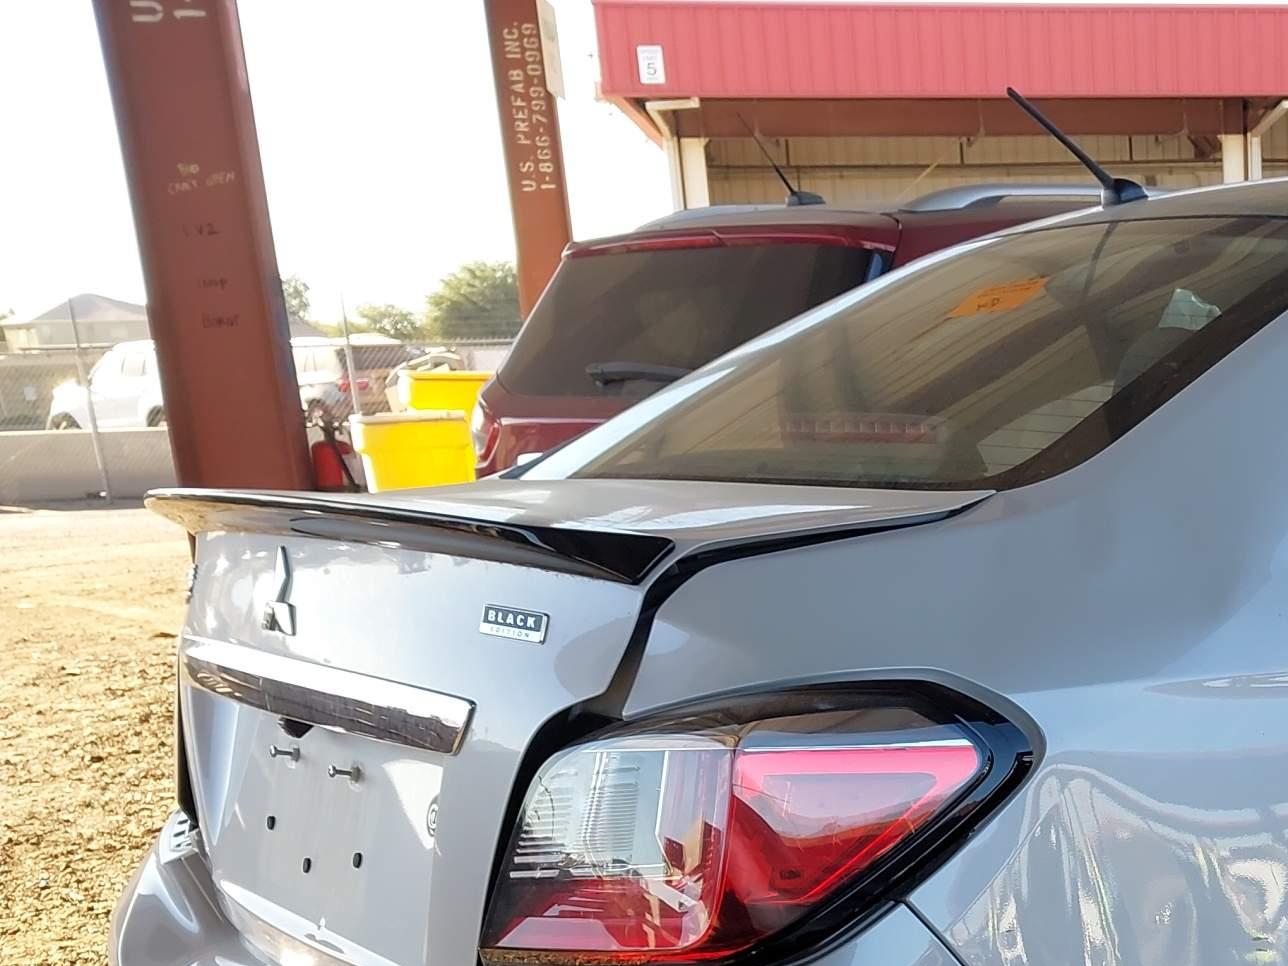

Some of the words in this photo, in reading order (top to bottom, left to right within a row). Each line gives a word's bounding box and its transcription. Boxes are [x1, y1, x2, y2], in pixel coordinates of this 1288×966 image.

[503, 21, 522, 59] INC.
[646, 62, 657, 76] 5
[508, 69, 532, 145] PREFAB
[521, 23, 557, 190] 1-866-799-0969
[519, 155, 537, 192] U.S.
[487, 609, 536, 629] BLACK
[489, 626, 531, 639] EDITION
